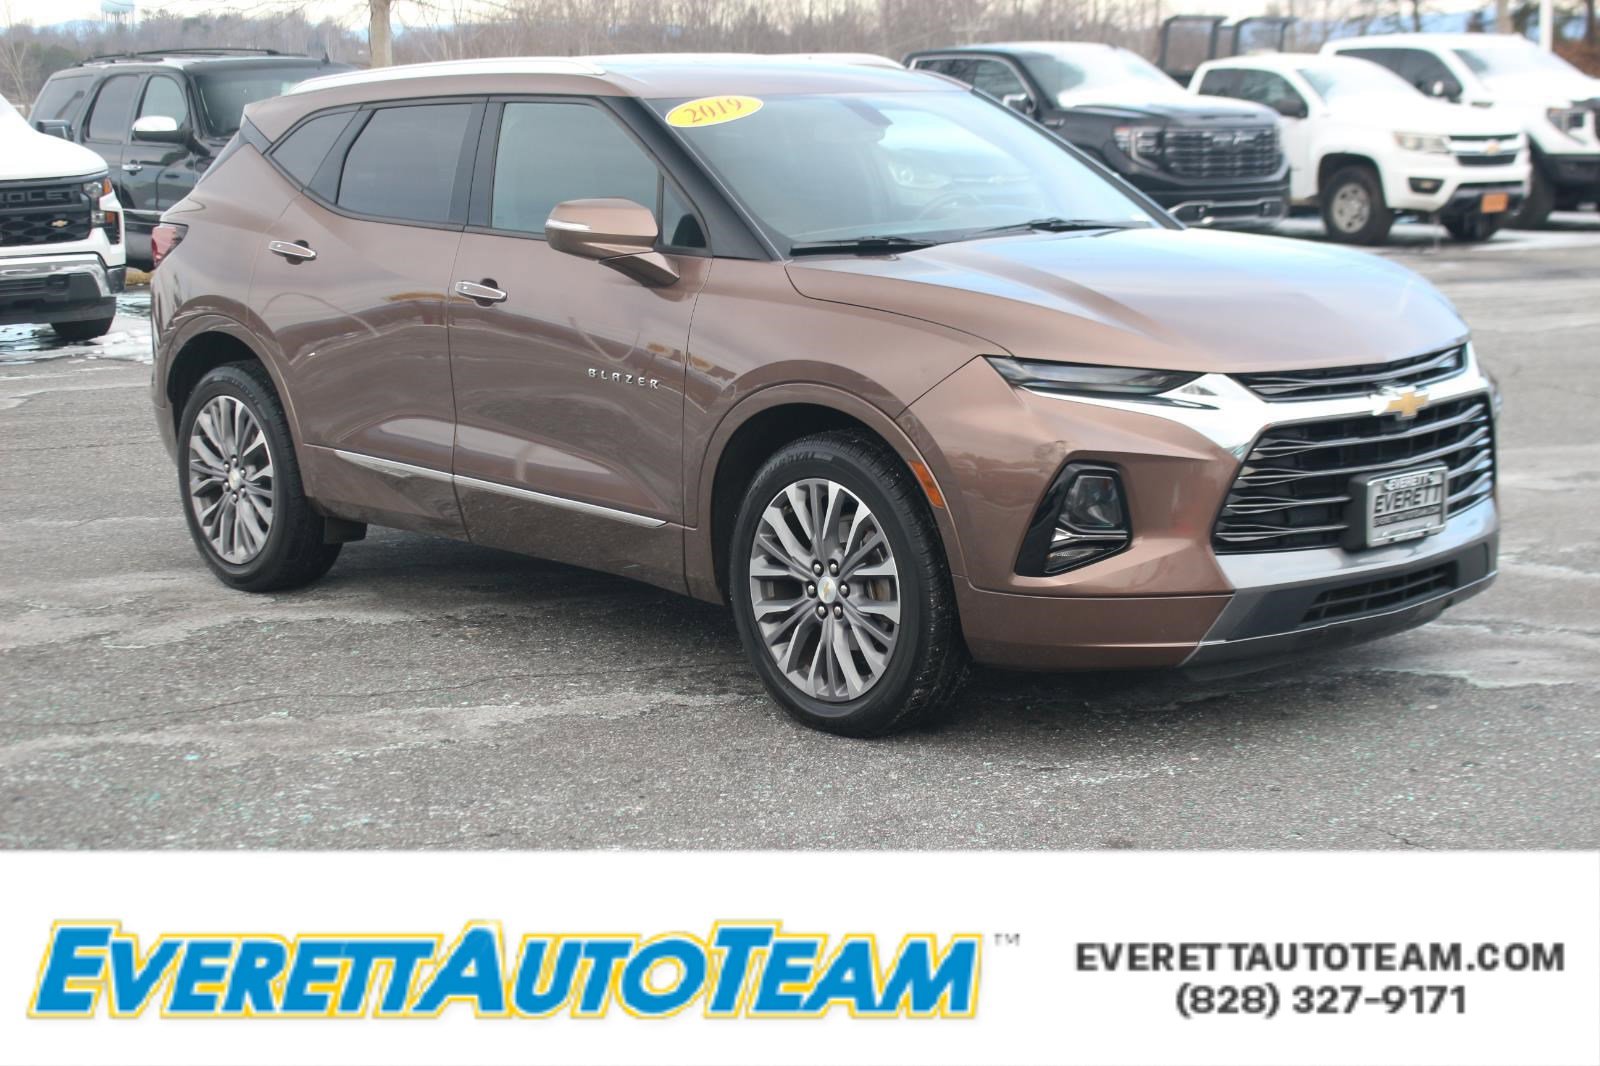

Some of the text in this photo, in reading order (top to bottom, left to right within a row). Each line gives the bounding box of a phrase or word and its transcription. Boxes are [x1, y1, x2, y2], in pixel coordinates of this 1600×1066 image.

[683, 98, 742, 123] 2019
[588, 368, 659, 390] BLAZER
[1373, 484, 1442, 514] EVERETT
